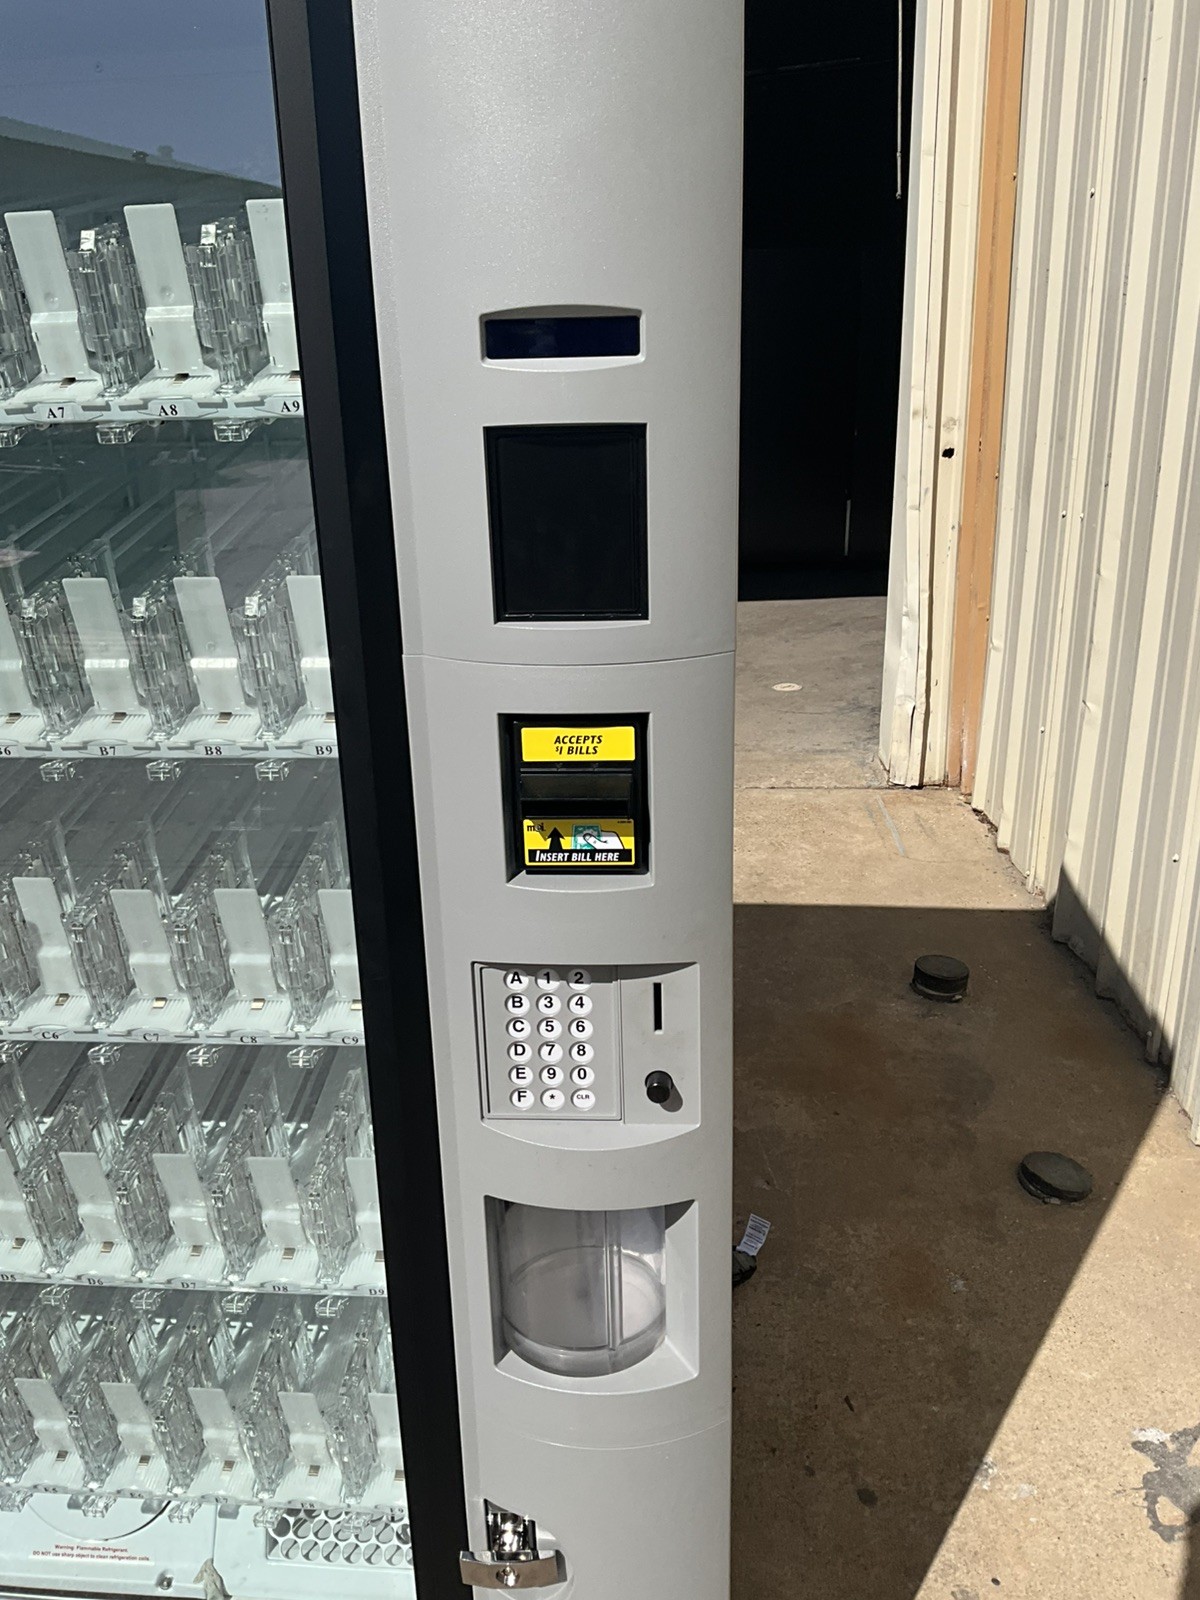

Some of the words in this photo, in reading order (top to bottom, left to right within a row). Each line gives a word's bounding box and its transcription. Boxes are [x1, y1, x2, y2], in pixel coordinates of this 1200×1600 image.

[158, 404, 178, 416] A8
[280, 400, 300, 413] A9
[46, 407, 65, 419] A7
[554, 735, 603, 745] ACCEPTS
[99, 746, 117, 756] B7
[204, 746, 223, 756] B8
[315, 745, 333, 755] B9
[567, 746, 599, 755] BILLS
[571, 852, 592, 862] BILL
[594, 852, 620, 862] HERE
[510, 971, 523, 984] A
[543, 971, 551, 984] 1
[573, 971, 585, 984] 2
[511, 995, 524, 1008] B
[543, 995, 554, 1008] 3
[574, 995, 585, 1008] 4
[512, 1019, 526, 1032] C
[545, 1020, 555, 1032] 5
[575, 1019, 586, 1032] 6
[41, 1031, 60, 1040] C6
[142, 1032, 160, 1042] C7
[239, 1035, 258, 1044] C8
[341, 1035, 360, 1045] C9
[514, 1043, 526, 1056] D
[545, 1043, 556, 1056] 7
[576, 1043, 587, 1056] 8
[515, 1067, 527, 1079] E
[546, 1067, 557, 1079] 9
[577, 1067, 588, 1079] 0
[517, 1090, 528, 1102] F
[272, 1284, 289, 1293] D8
[368, 1287, 385, 1296] D9
